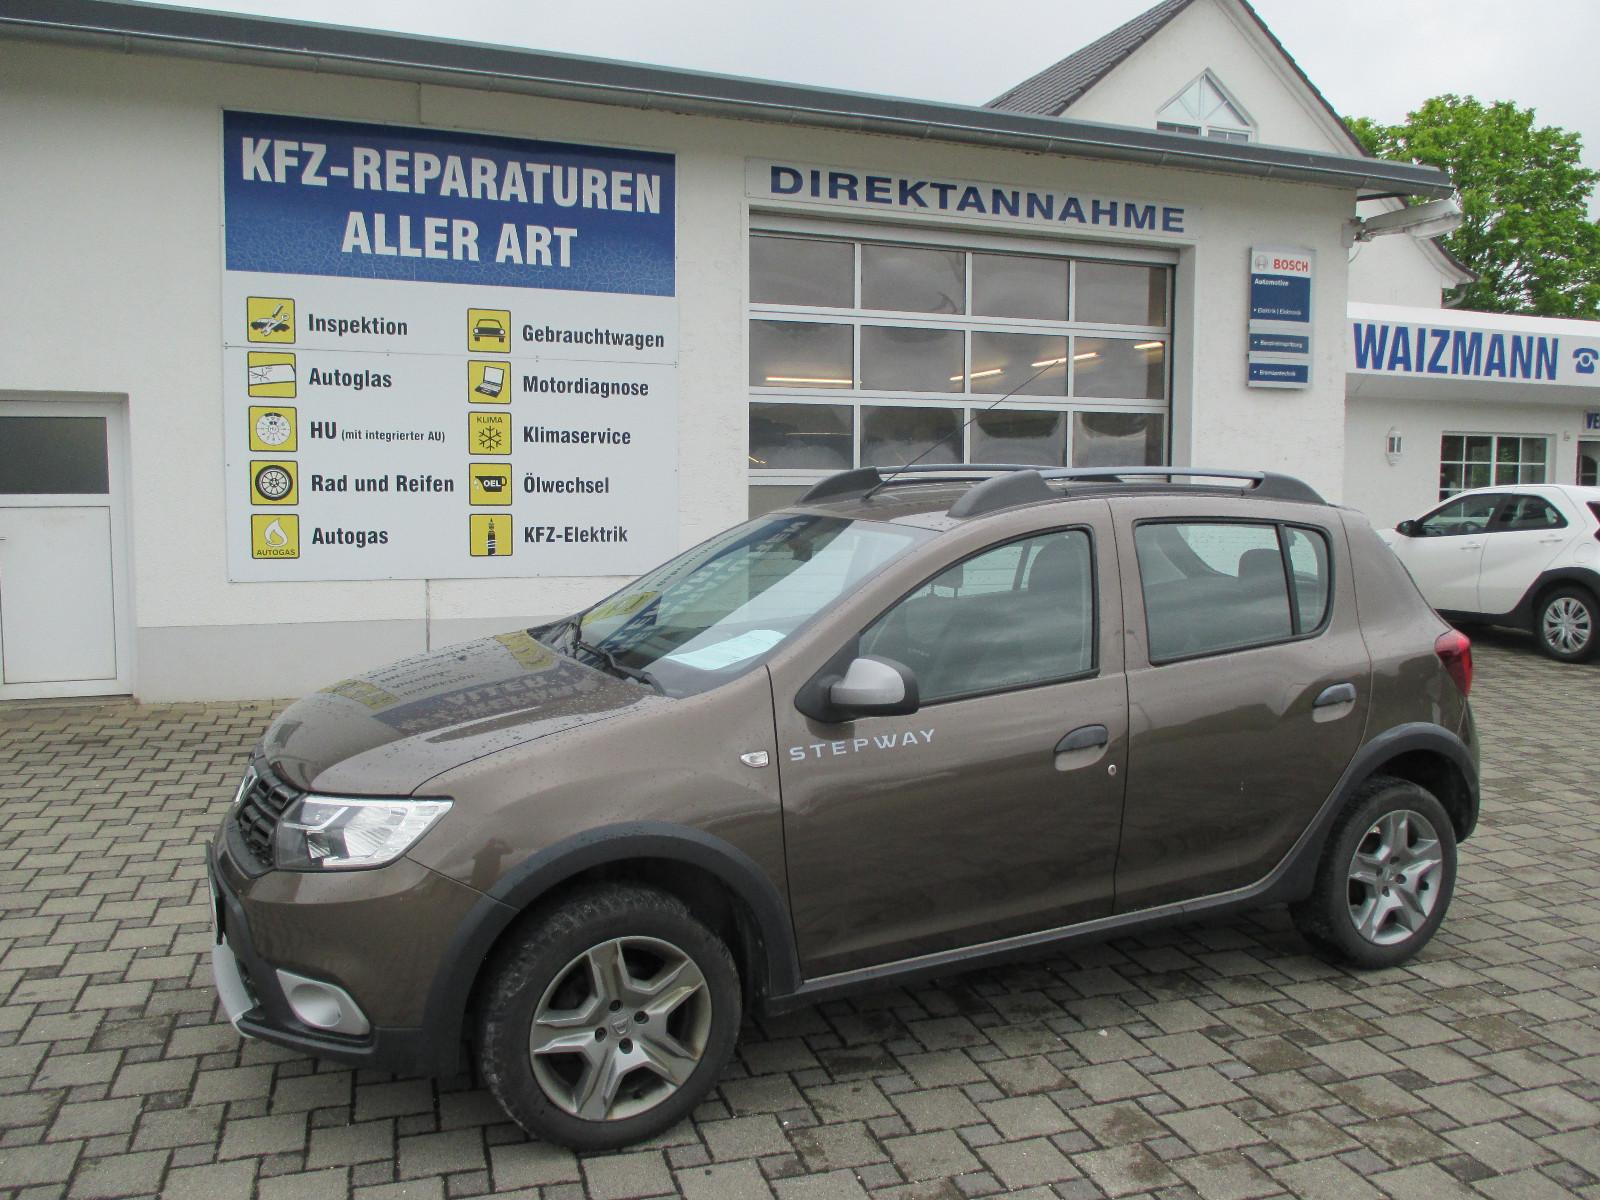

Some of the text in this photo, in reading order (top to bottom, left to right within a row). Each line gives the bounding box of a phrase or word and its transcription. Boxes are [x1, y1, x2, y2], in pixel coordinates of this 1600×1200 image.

[241, 136, 661, 214] KFZ-REPARATUREN
[770, 165, 1185, 233] DIREKTANNAHME
[341, 210, 578, 268] ALLER ART
[1273, 258, 1309, 272] BOSCH
[1254, 278, 1289, 287] Automotive
[308, 313, 408, 336] Inspektion
[522, 324, 665, 351] Gebrauchtwagen
[1353, 322, 1559, 381] WAIZMANN
[308, 367, 393, 390] Autoglas
[522, 375, 649, 398] Motordiagnose
[476, 416, 503, 424] KLIMA
[310, 421, 446, 443] HU (mit integrierter AU)
[523, 426, 631, 445] Klimaservice
[311, 474, 455, 493] Rad und Reifen
[483, 479, 502, 487] OEL
[523, 472, 610, 494] Ölwechsel
[311, 527, 389, 548] Autogas
[524, 526, 628, 543] KFZ-Elektrik
[788, 728, 936, 762] STEPWAY
